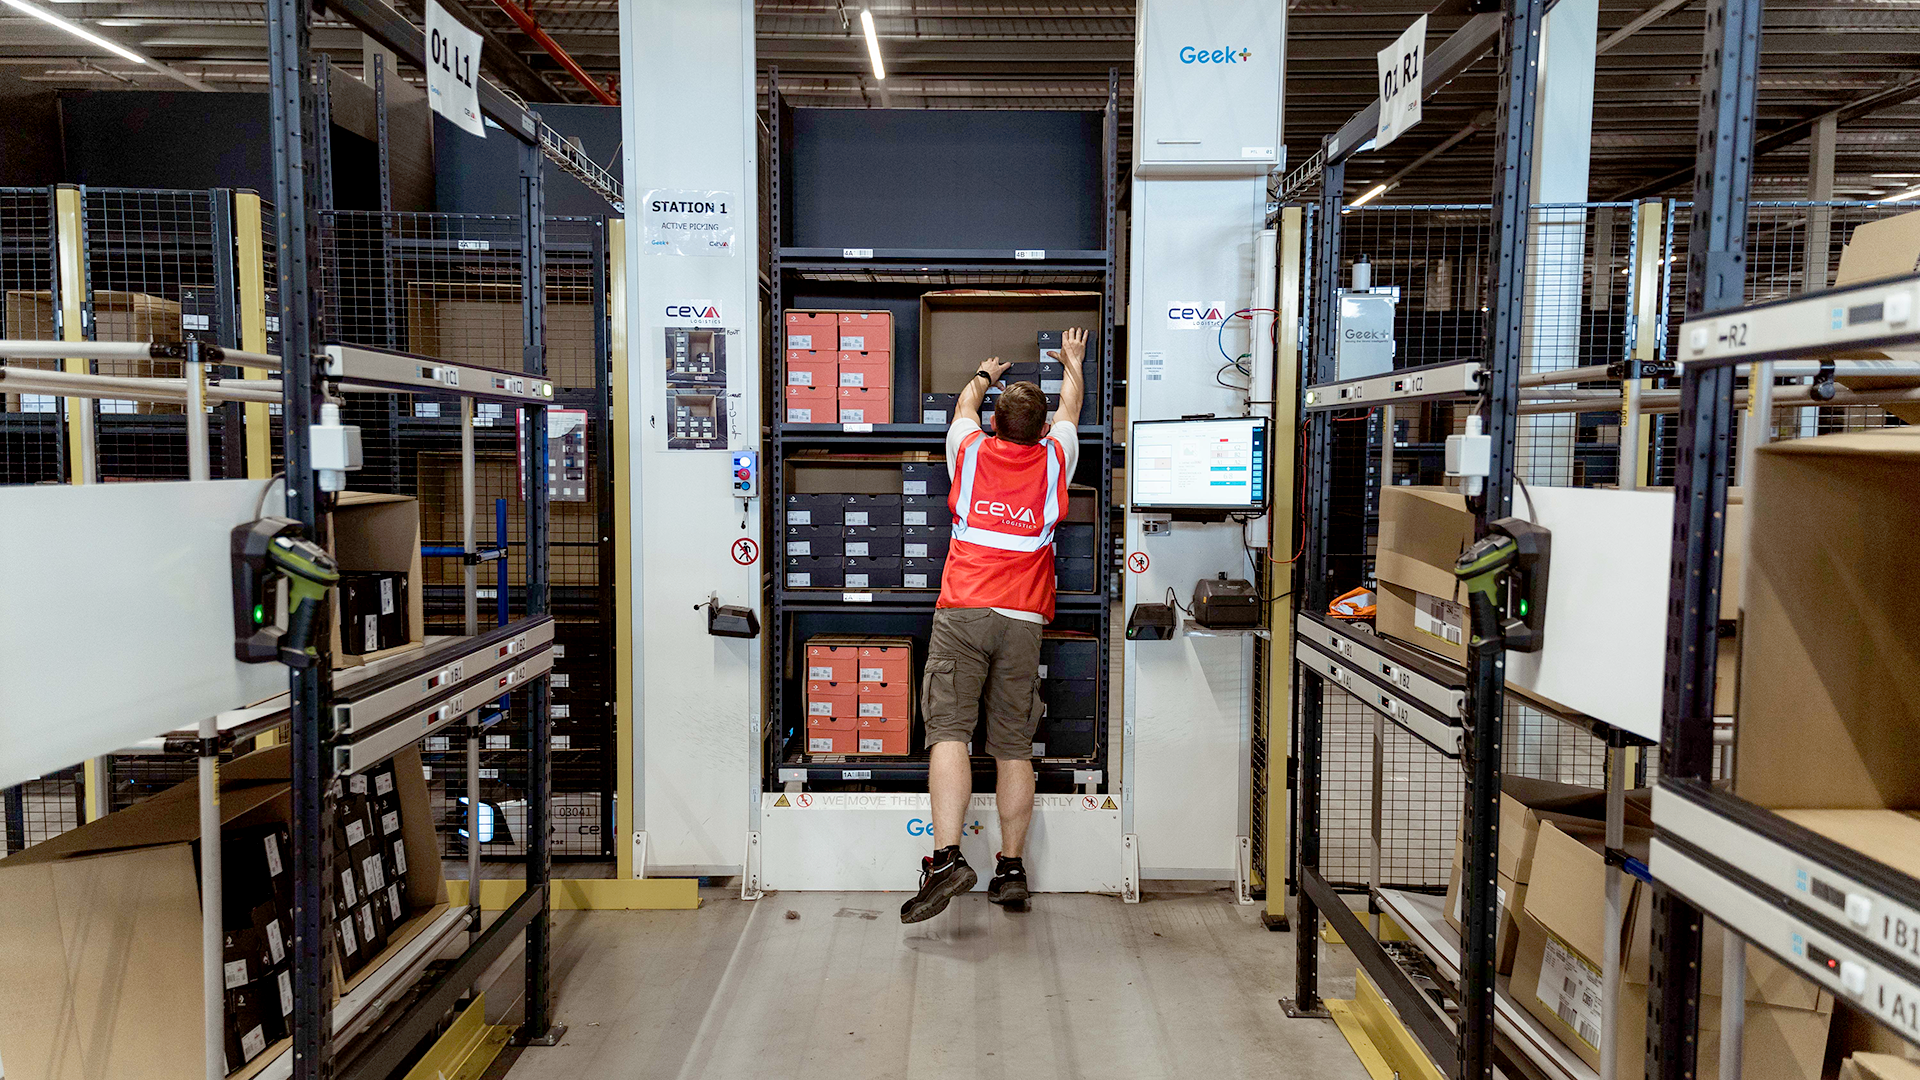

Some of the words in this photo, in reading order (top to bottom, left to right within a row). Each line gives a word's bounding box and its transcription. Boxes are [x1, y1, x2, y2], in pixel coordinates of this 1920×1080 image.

[432, 28, 450, 73] 01
[455, 46, 472, 89] L1
[1179, 46, 1252, 64] Geek+
[1384, 63, 1398, 102] 01
[1402, 45, 1419, 88] R1
[652, 200, 715, 213] STATION
[720, 202, 728, 214] 1
[661, 222, 688, 230] ACTIVE
[689, 223, 719, 231] PICKING
[665, 305, 721, 318] CEVA
[1168, 307, 1223, 320] CEVA
[1344, 328, 1389, 340] Geek+
[449, 370, 458, 385] C1
[1415, 377, 1423, 391] C2
[516, 381, 523, 394] C2
[1356, 386, 1363, 399] C1
[974, 500, 1036, 524] CEVA
[1001, 519, 1037, 530] LOGISTICS
[454, 666, 462, 682] B1
[1403, 673, 1410, 689] B2
[1401, 708, 1408, 724] A2
[822, 796, 844, 805] WE
[848, 796, 886, 806] MOVE
[890, 796, 916, 806] THE
[559, 807, 592, 817] 03041
[906, 818, 984, 837] Gek+
[1895, 917, 1919, 956] B1
[1892, 994, 1918, 1031] A1
